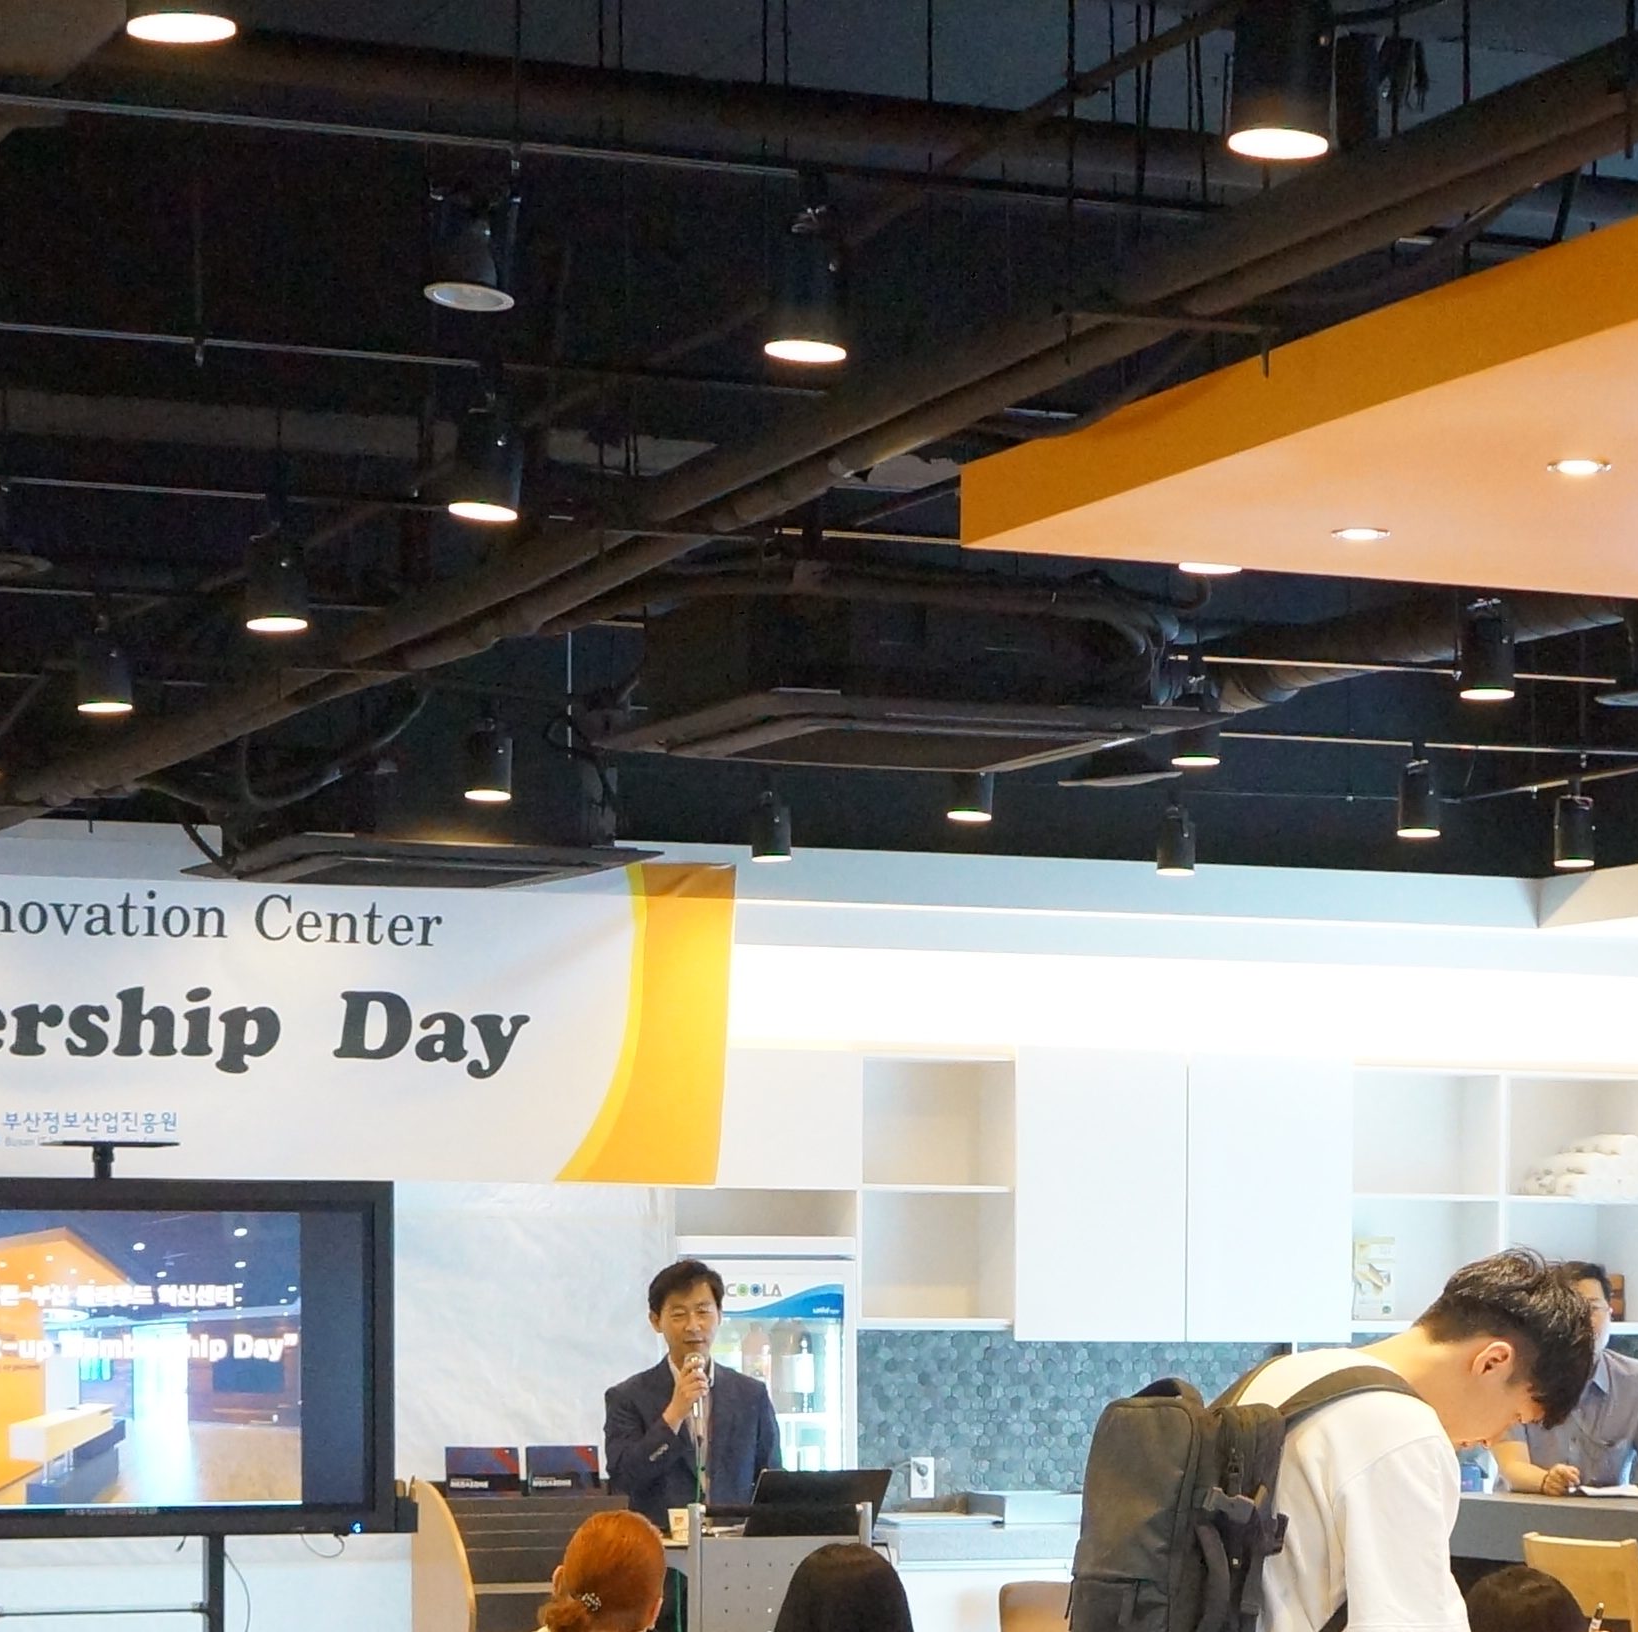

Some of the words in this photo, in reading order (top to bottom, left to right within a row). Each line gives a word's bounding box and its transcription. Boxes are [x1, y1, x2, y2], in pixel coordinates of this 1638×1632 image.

[254, 894, 443, 948] Center
[332, 990, 530, 1080] Day
[2, 1111, 178, 1135] 부산정보산업진흥원
